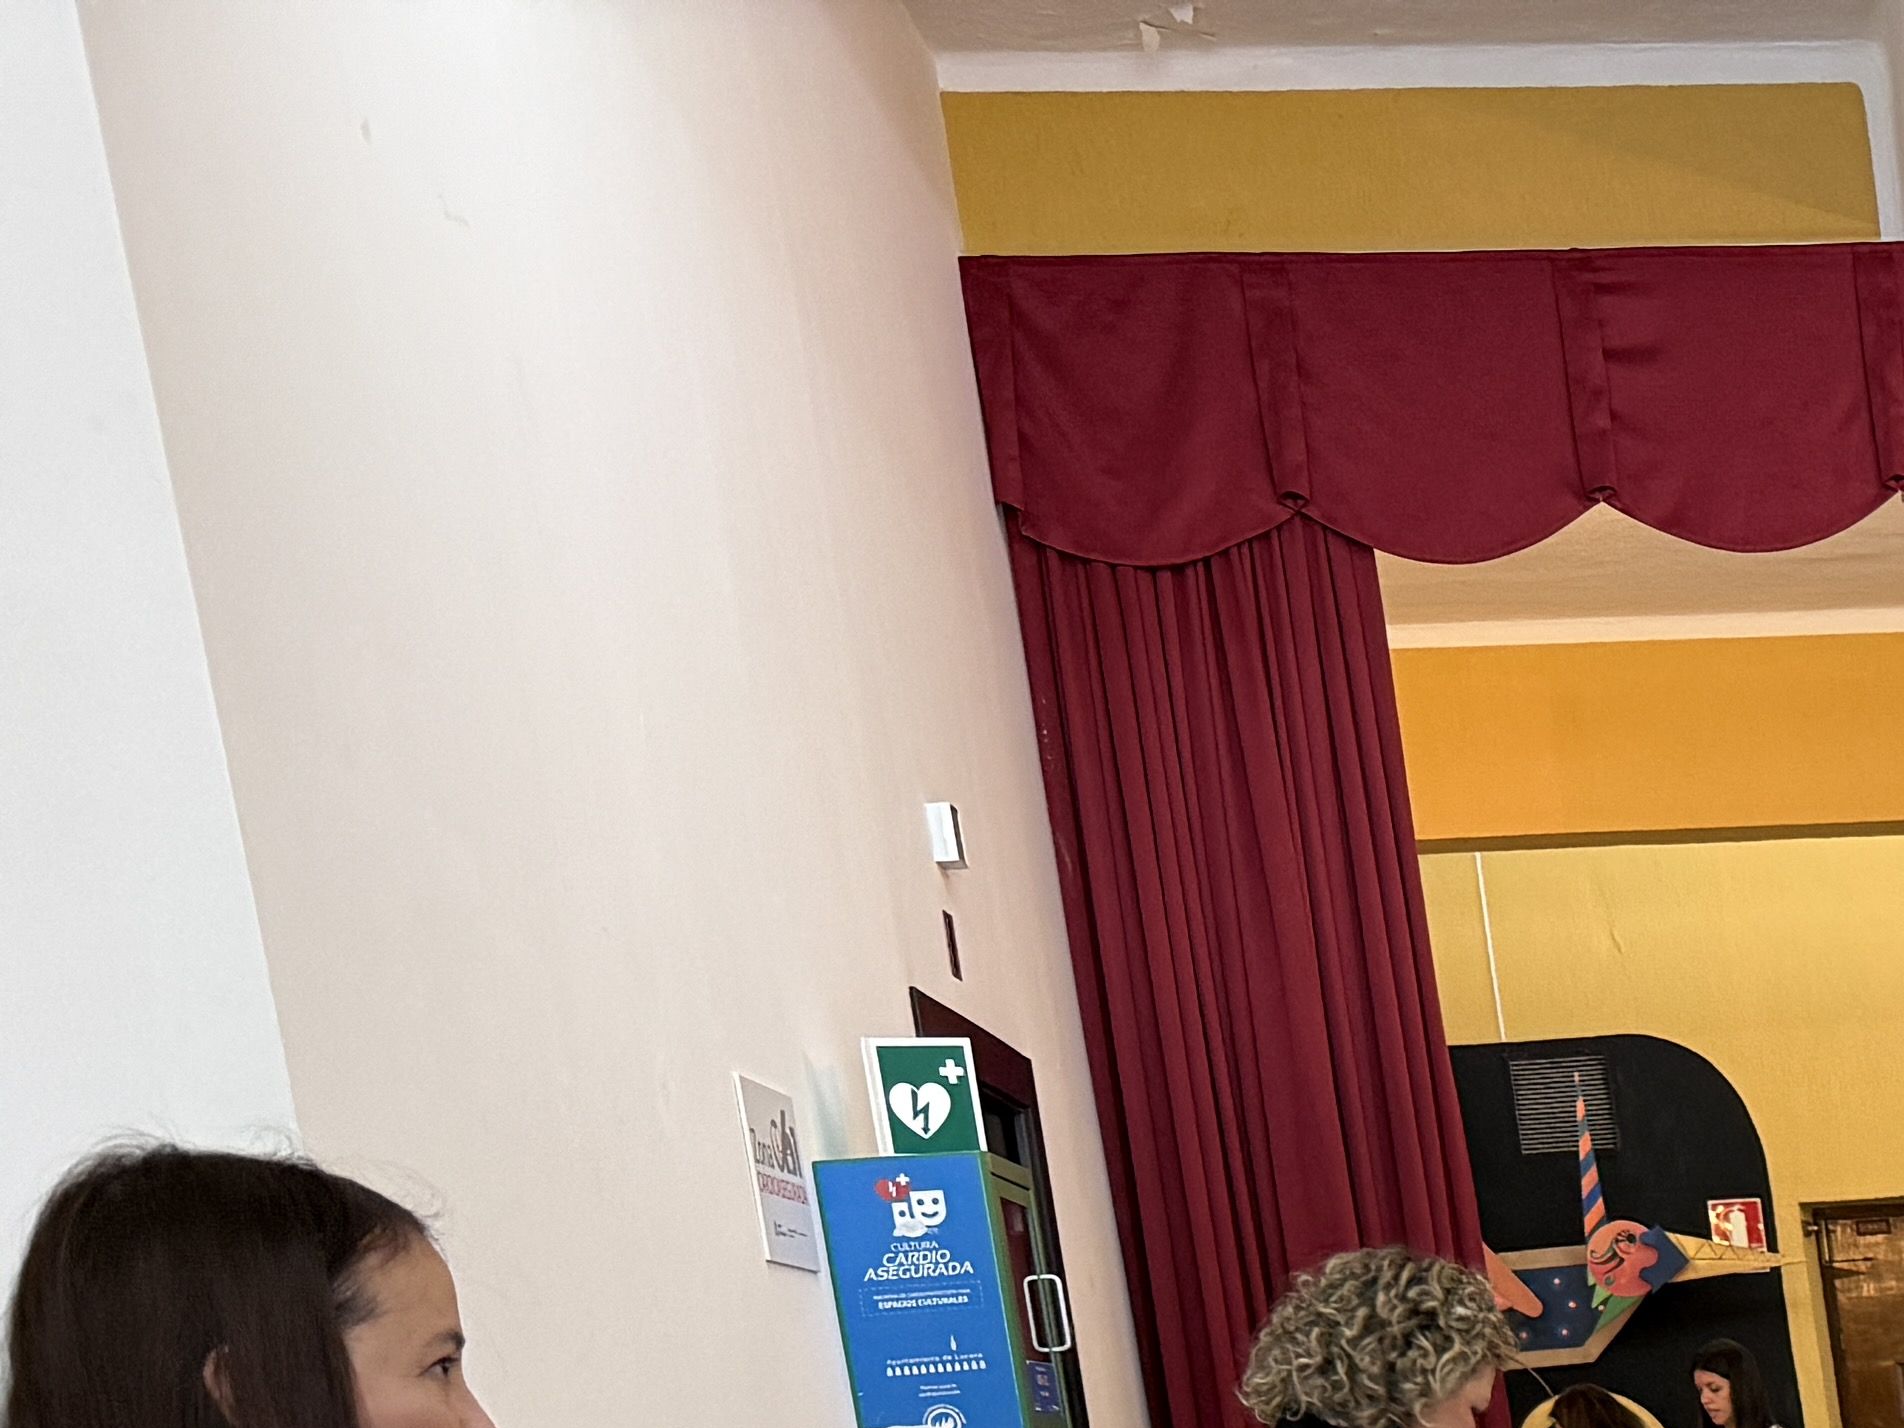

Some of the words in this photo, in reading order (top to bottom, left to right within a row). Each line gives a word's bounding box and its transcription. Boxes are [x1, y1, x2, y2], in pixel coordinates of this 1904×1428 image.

[890, 1240, 939, 1252] CULTURA
[882, 1249, 951, 1267] CARDIO
[864, 1261, 974, 1281] ASEGURADA
